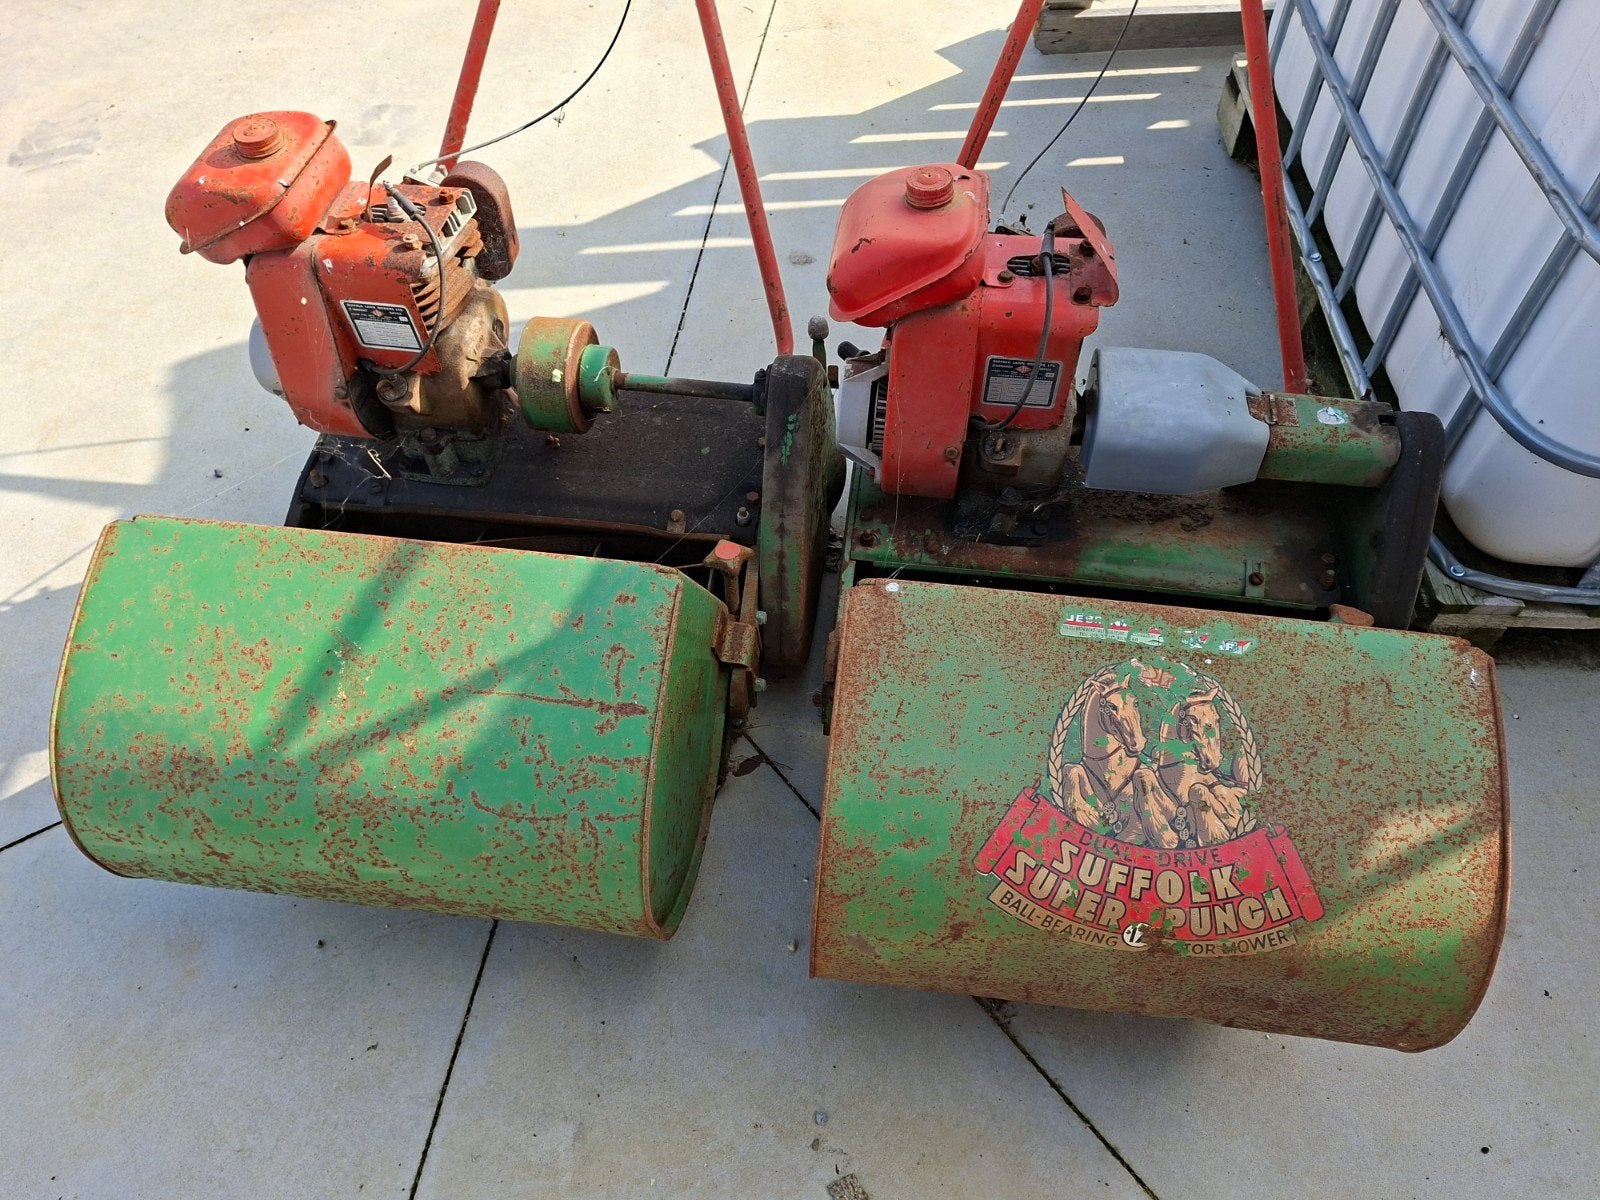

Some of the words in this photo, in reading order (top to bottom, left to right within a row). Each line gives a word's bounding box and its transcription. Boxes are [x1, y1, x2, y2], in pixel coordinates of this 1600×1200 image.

[1003, 849, 1128, 932] SUPER
[1163, 886, 1294, 938] PUNCH
[1050, 839, 1245, 905] SUFFOLK
[1000, 890, 1119, 948] BALL-BEARING
